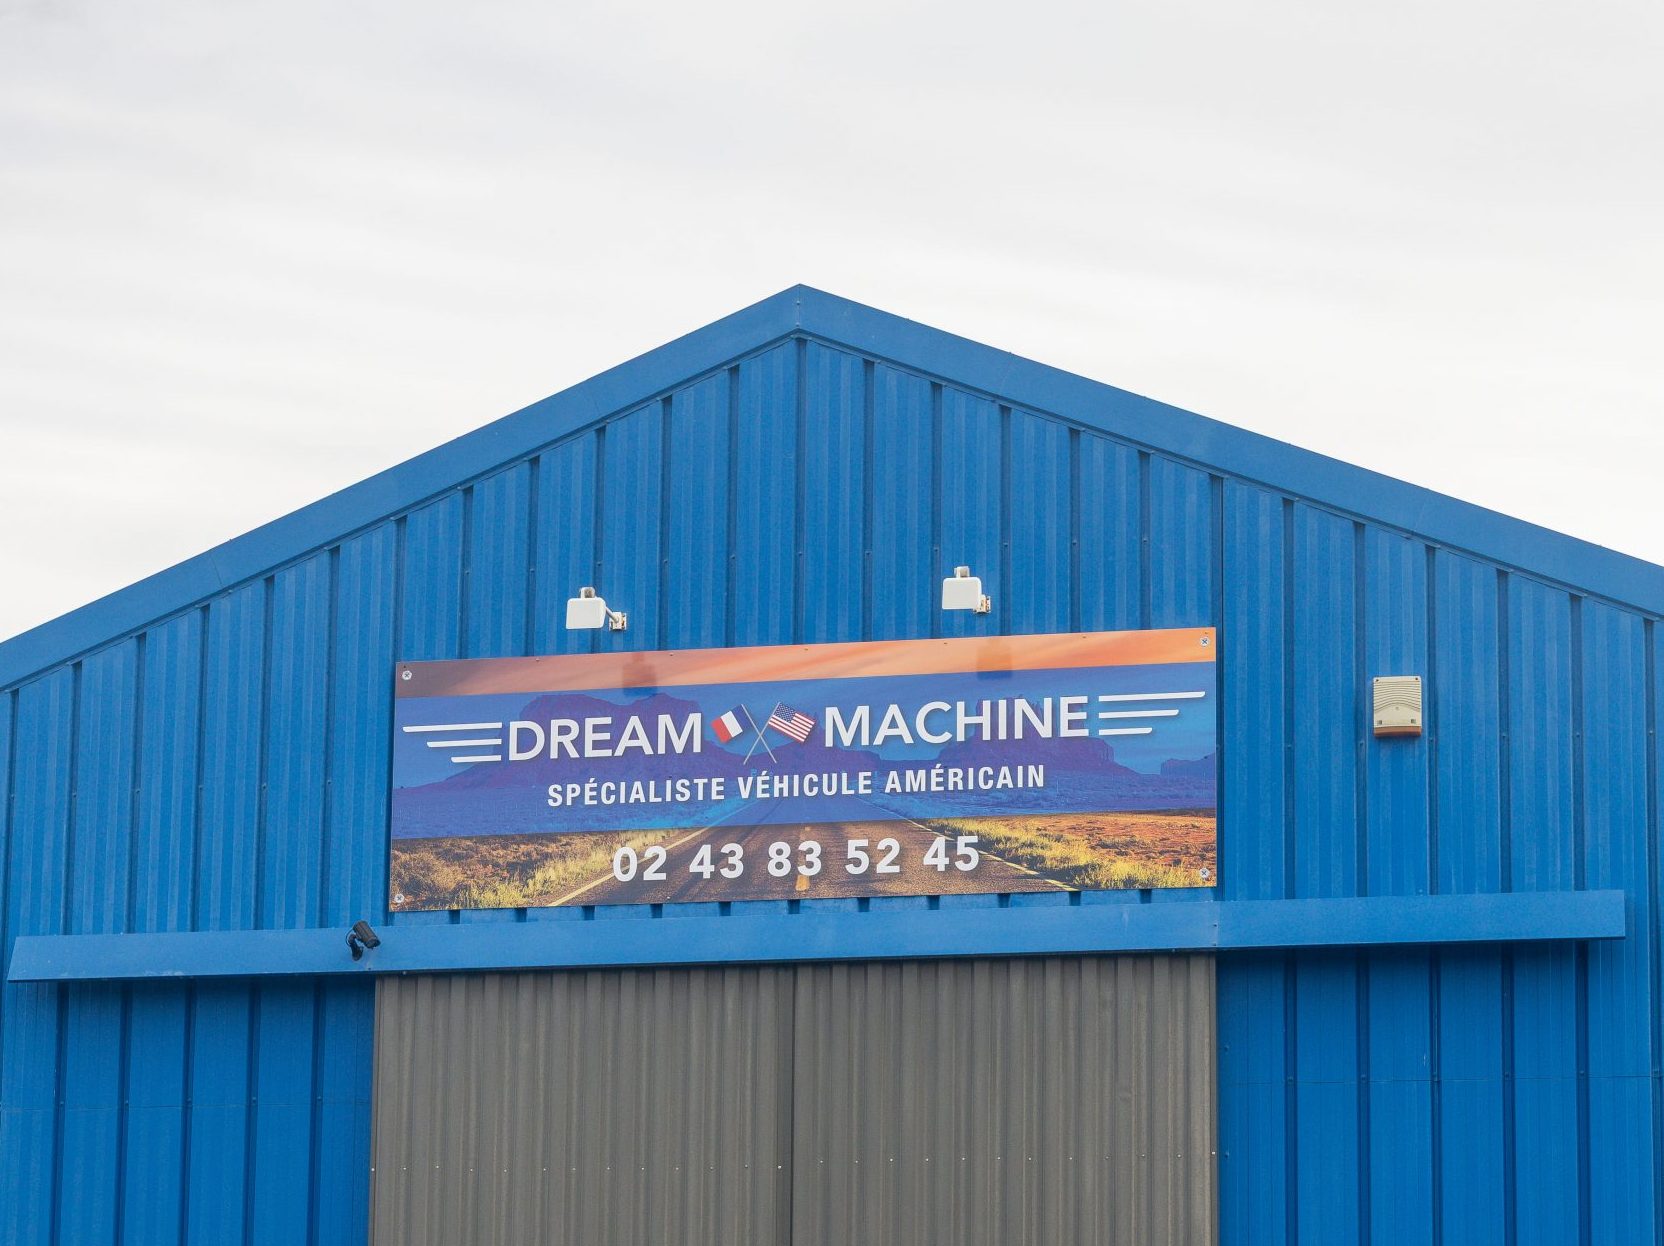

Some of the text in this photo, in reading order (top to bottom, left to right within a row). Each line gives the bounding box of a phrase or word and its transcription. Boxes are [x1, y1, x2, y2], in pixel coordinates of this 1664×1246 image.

[508, 695, 1090, 762] DREAM MACHINE
[547, 762, 1046, 807] SPÉCIALISTE VÉHICULE AMÉRICAIN
[612, 835, 980, 883] 02 43 83 52 45
